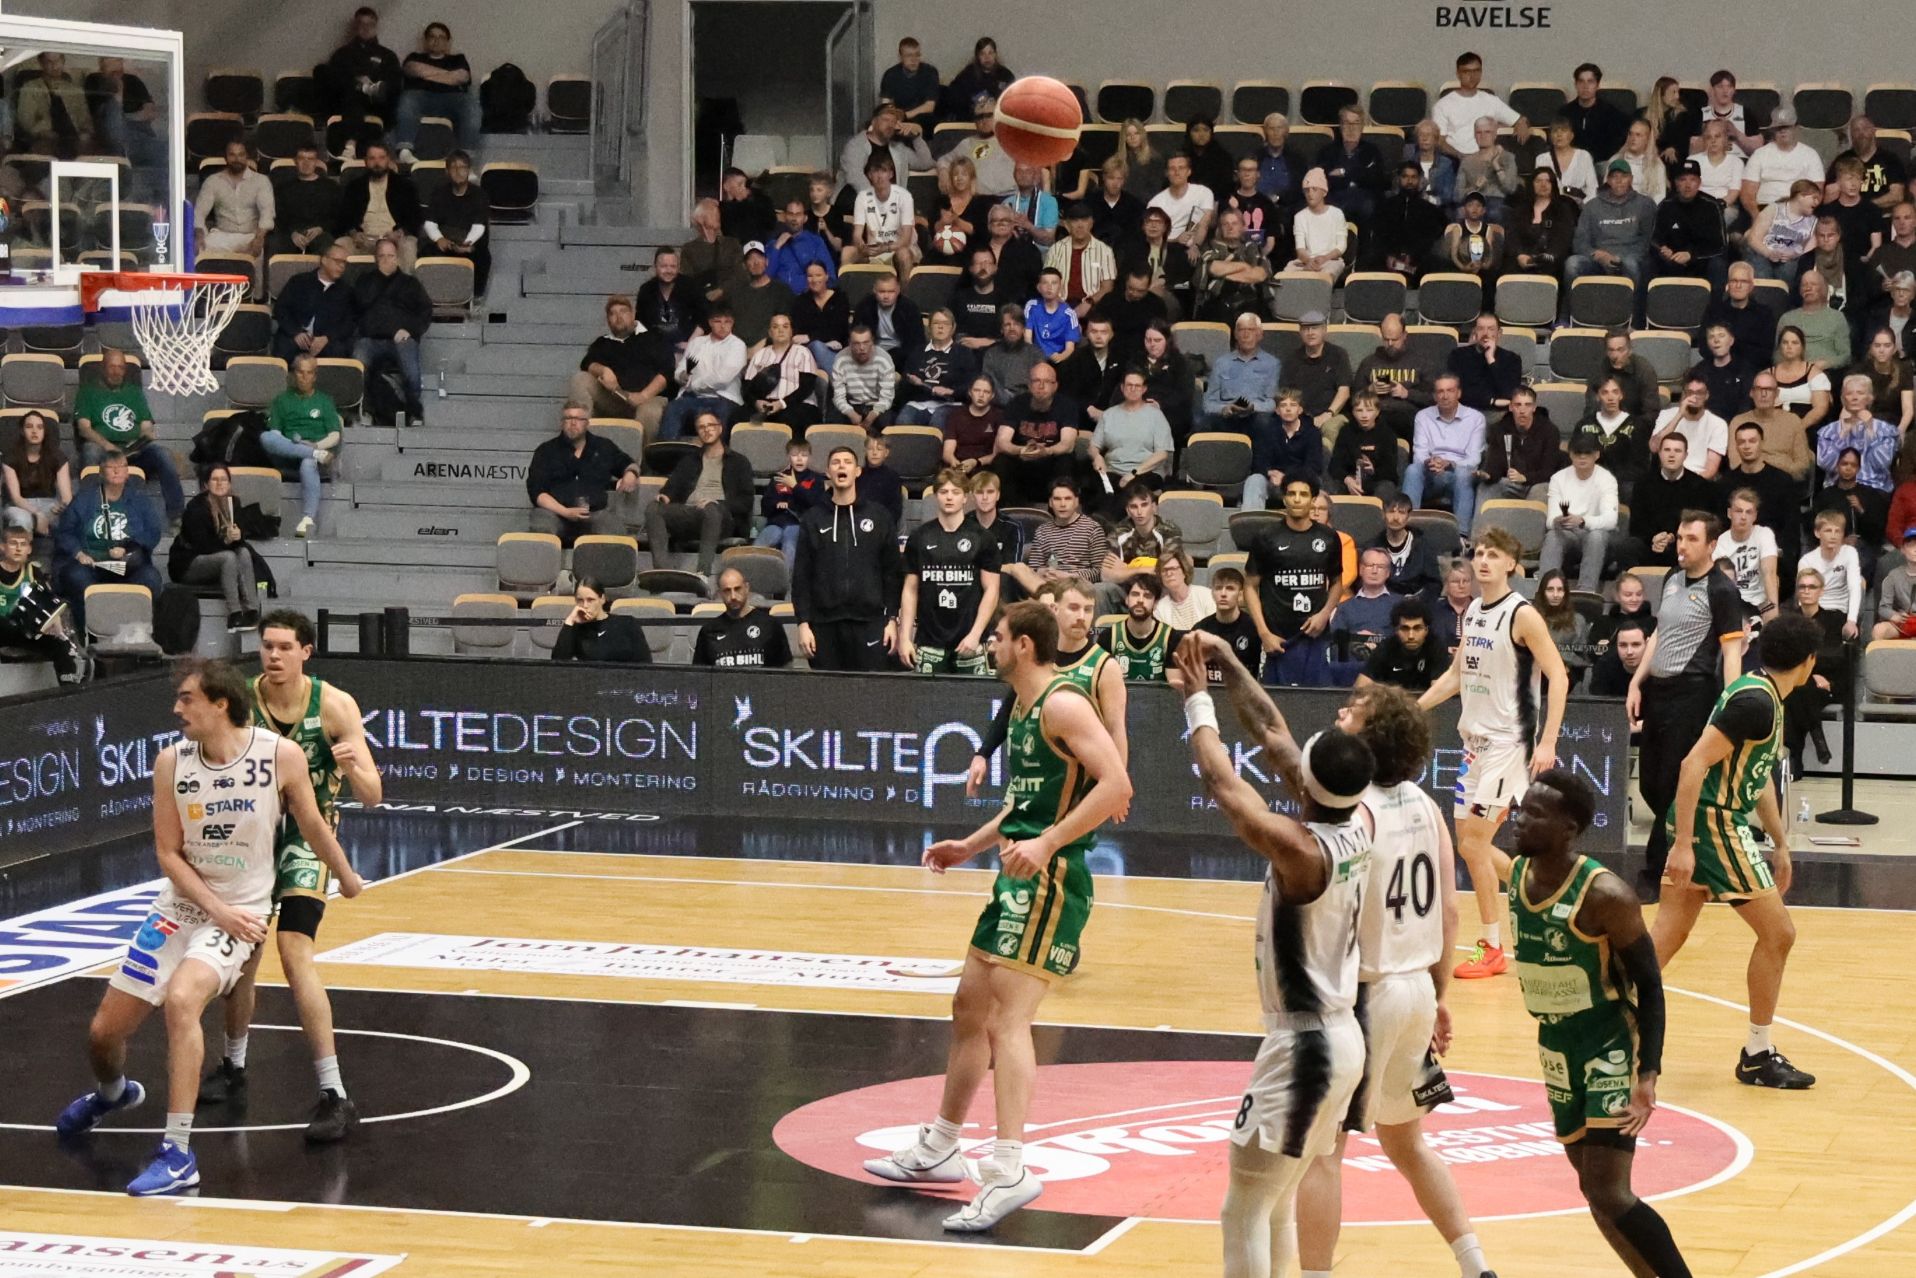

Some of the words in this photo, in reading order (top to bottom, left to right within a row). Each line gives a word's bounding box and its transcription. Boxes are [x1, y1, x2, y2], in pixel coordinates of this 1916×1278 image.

[1436, 6, 1552, 28] BAVELSE
[413, 462, 472, 478] ARENA
[474, 465, 528, 480] NÆSTV
[417, 525, 458, 536] elan
[922, 570, 944, 582] PER
[945, 569, 974, 582] BIHL
[1274, 574, 1298, 587] PER
[1466, 636, 1494, 651] STARK
[736, 653, 764, 665] BIHL
[1208, 669, 1223, 682] ER
[361, 709, 697, 761] KILTEDESIGN
[0, 747, 80, 806] ESIGN
[243, 758, 273, 787] 35
[467, 767, 544, 784] DESIGN
[573, 771, 697, 790] MONTERING
[742, 779, 875, 801] RÅDGIVNING
[205, 799, 256, 816] STARK
[443, 806, 660, 821] NÆSTVED
[17, 807, 80, 834] MONTERING
[1385, 852, 1436, 923] 40
[205, 928, 238, 957] 35
[603, 945, 893, 967] Johansen
[1235, 1093, 1253, 1130] 8
[0, 1240, 237, 1265] ansen
